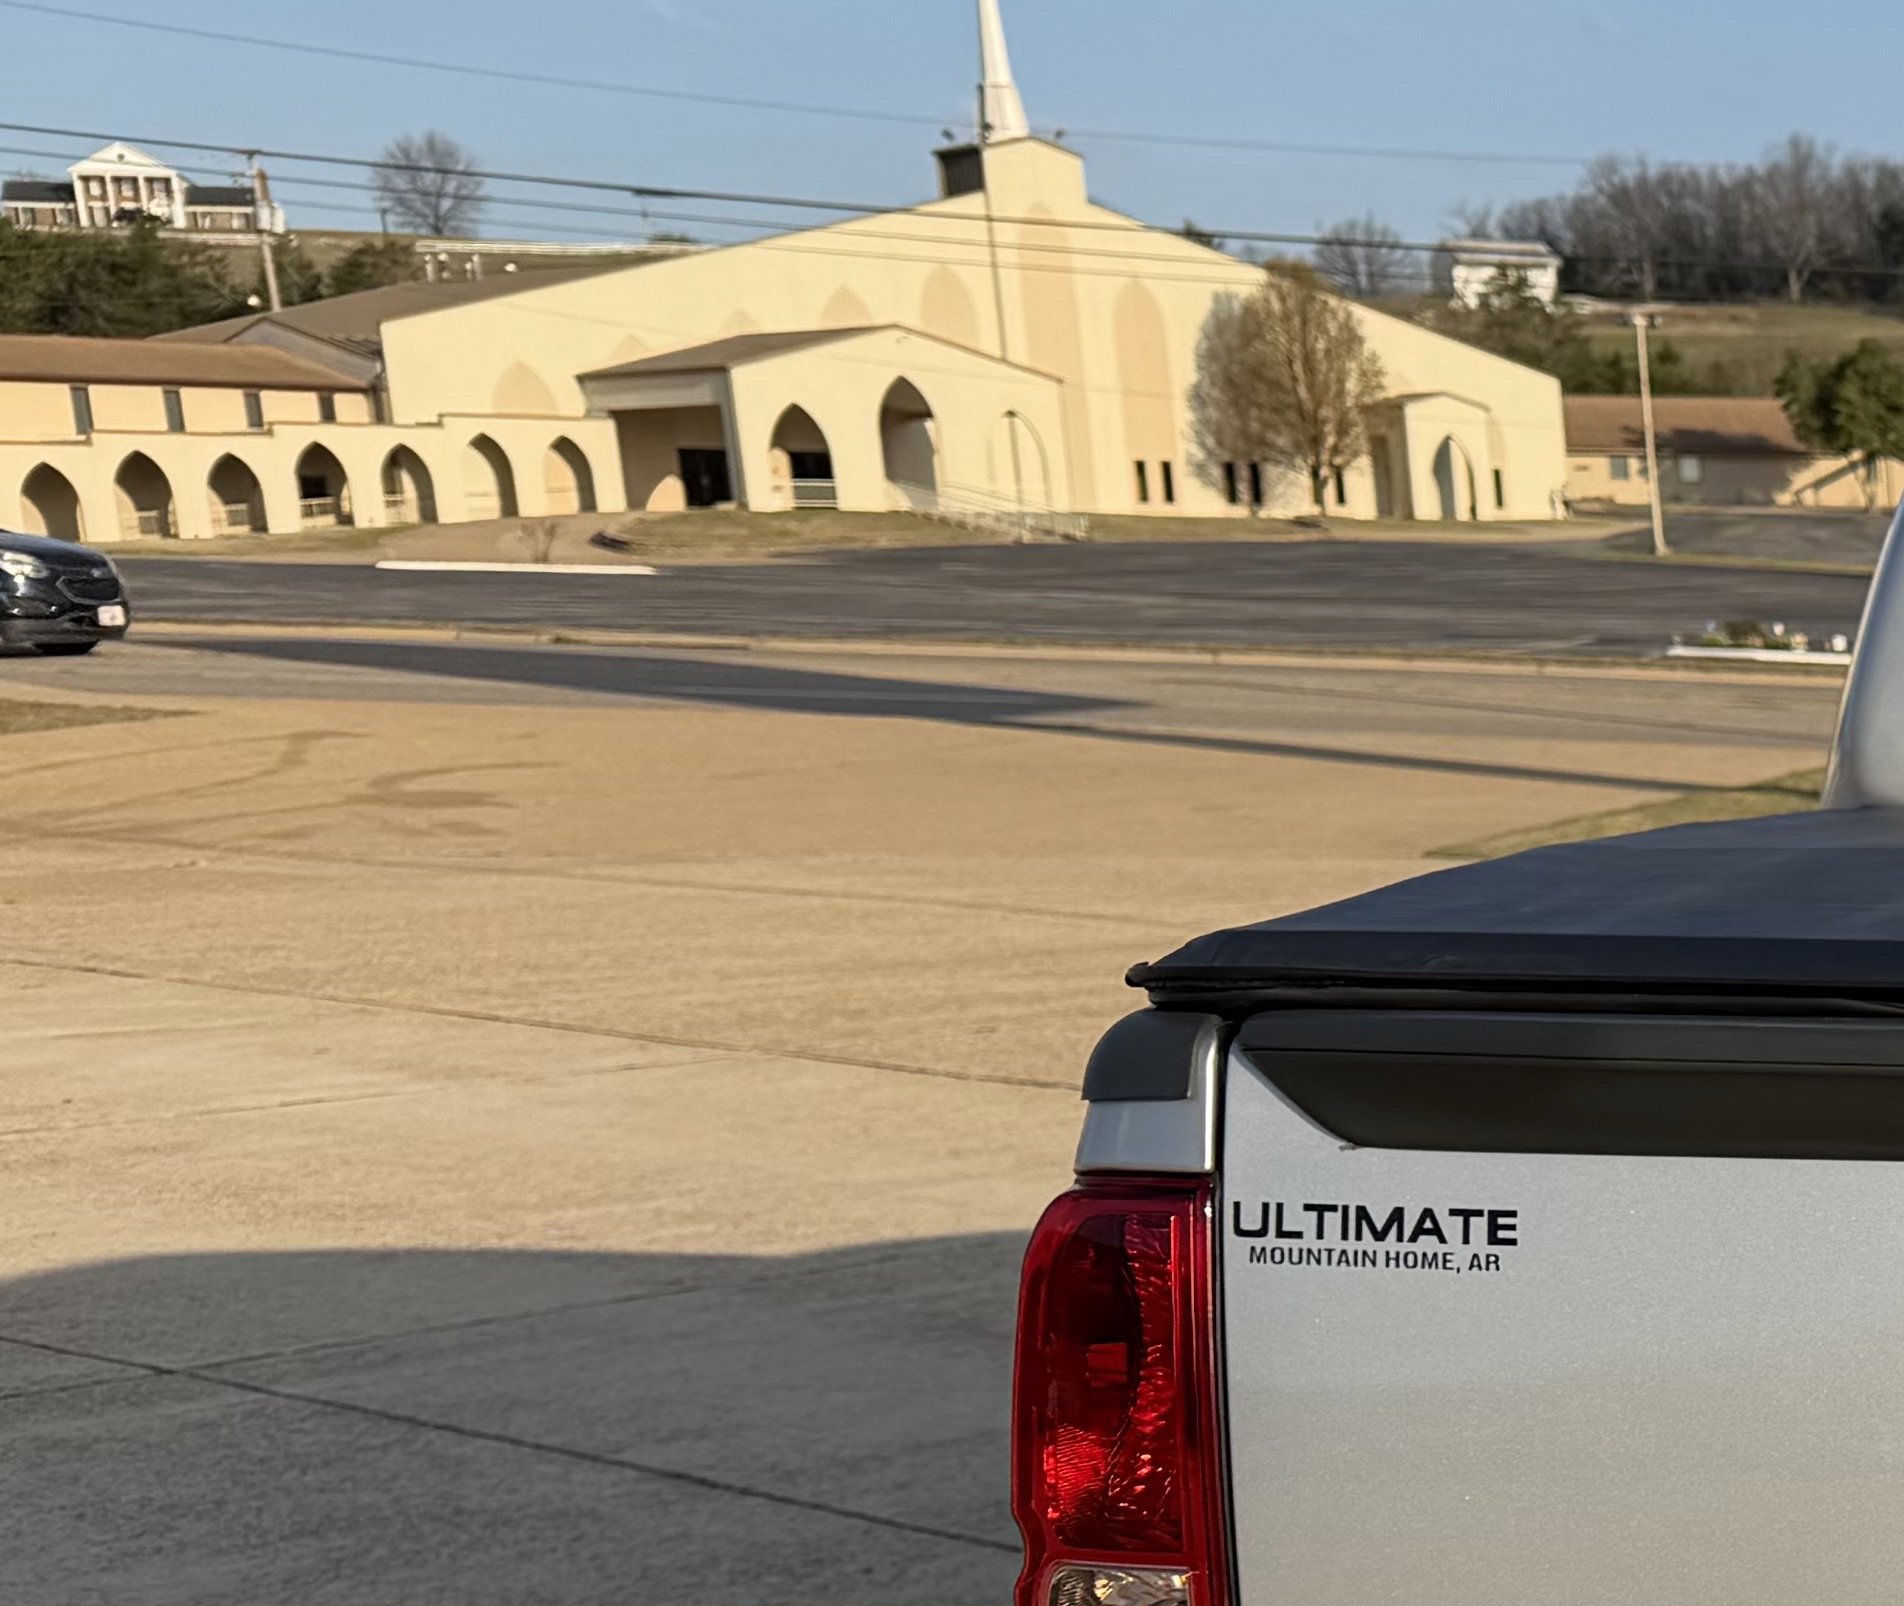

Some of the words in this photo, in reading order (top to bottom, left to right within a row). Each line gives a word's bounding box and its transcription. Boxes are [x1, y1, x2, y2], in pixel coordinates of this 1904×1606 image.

[1233, 1201, 1518, 1246] ULTIMATE
[1250, 1246, 1377, 1267] MOUNTAIN
[1385, 1251, 1461, 1274] HOME,
[1468, 1253, 1500, 1271] AR
